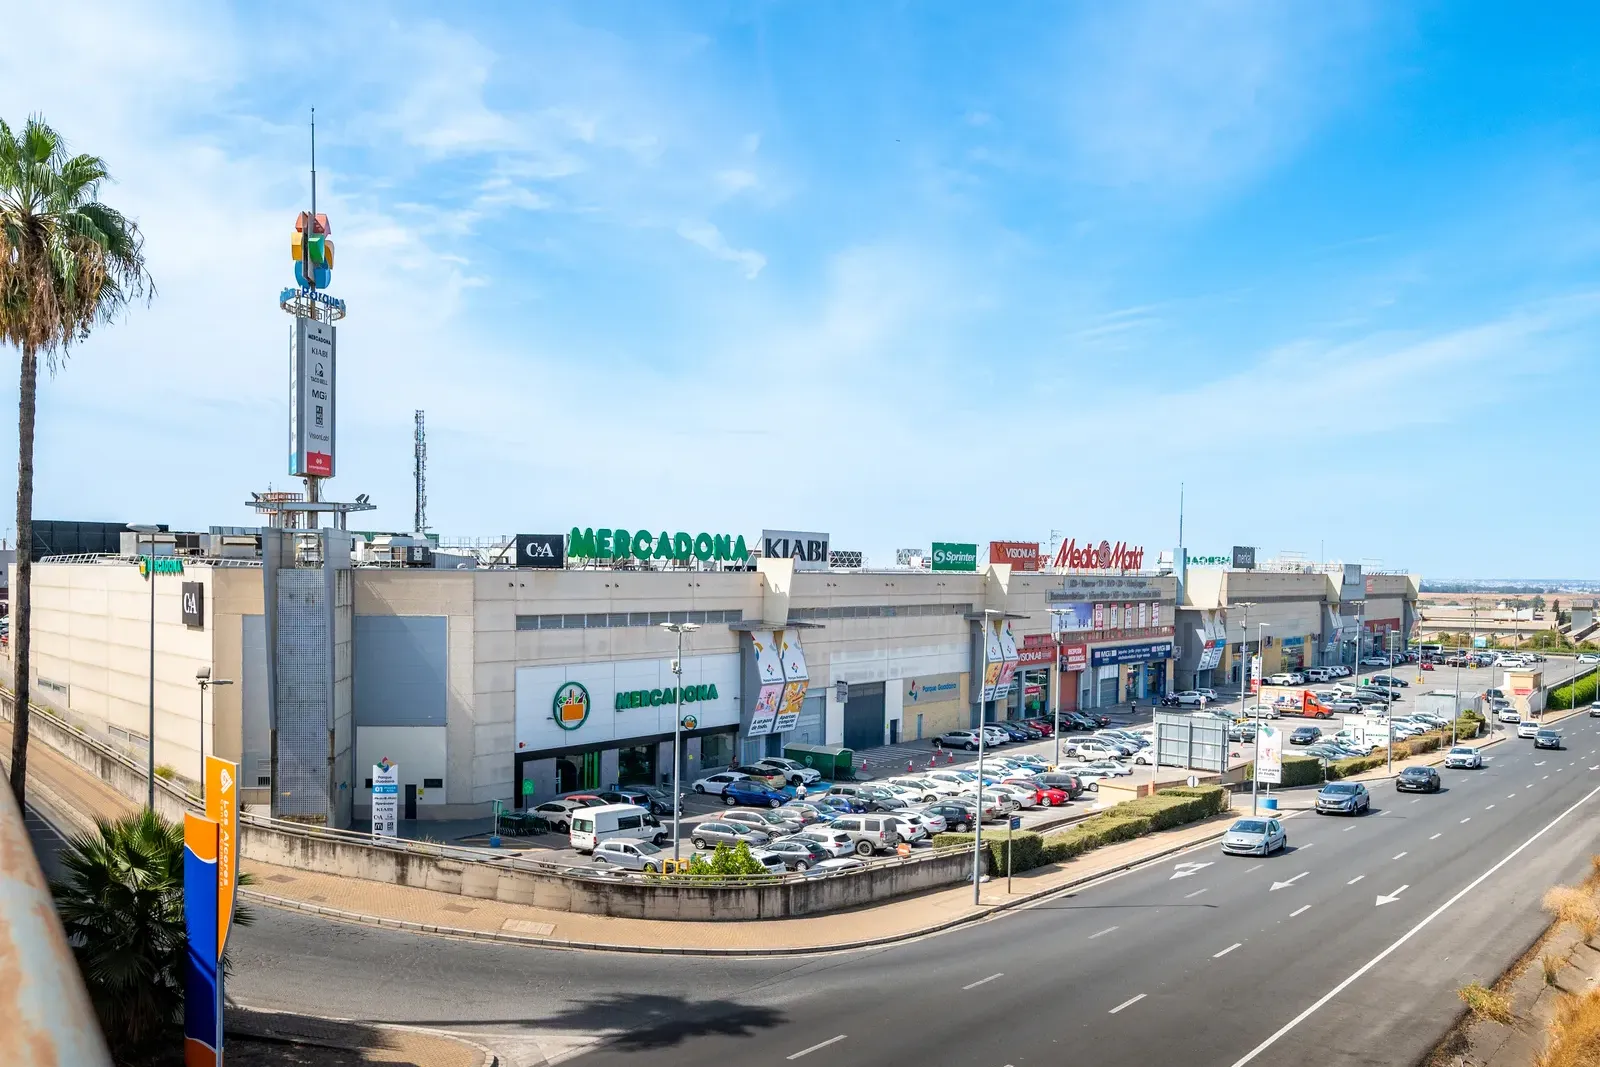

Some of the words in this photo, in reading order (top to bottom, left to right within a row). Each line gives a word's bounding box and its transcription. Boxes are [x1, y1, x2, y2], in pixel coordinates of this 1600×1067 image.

[308, 333, 332, 346] MERCADONA
[311, 347, 328, 358] KIABI
[526, 542, 554, 557] C&A
[568, 527, 749, 561] MERCADONA
[765, 538, 828, 562] KIABI
[946, 551, 976, 564] Sprinter
[1006, 547, 1037, 559] VISIONLAB
[184, 593, 197, 614] C&A
[922, 685, 937, 693] Parque
[616, 684, 719, 709] MERCADONA
